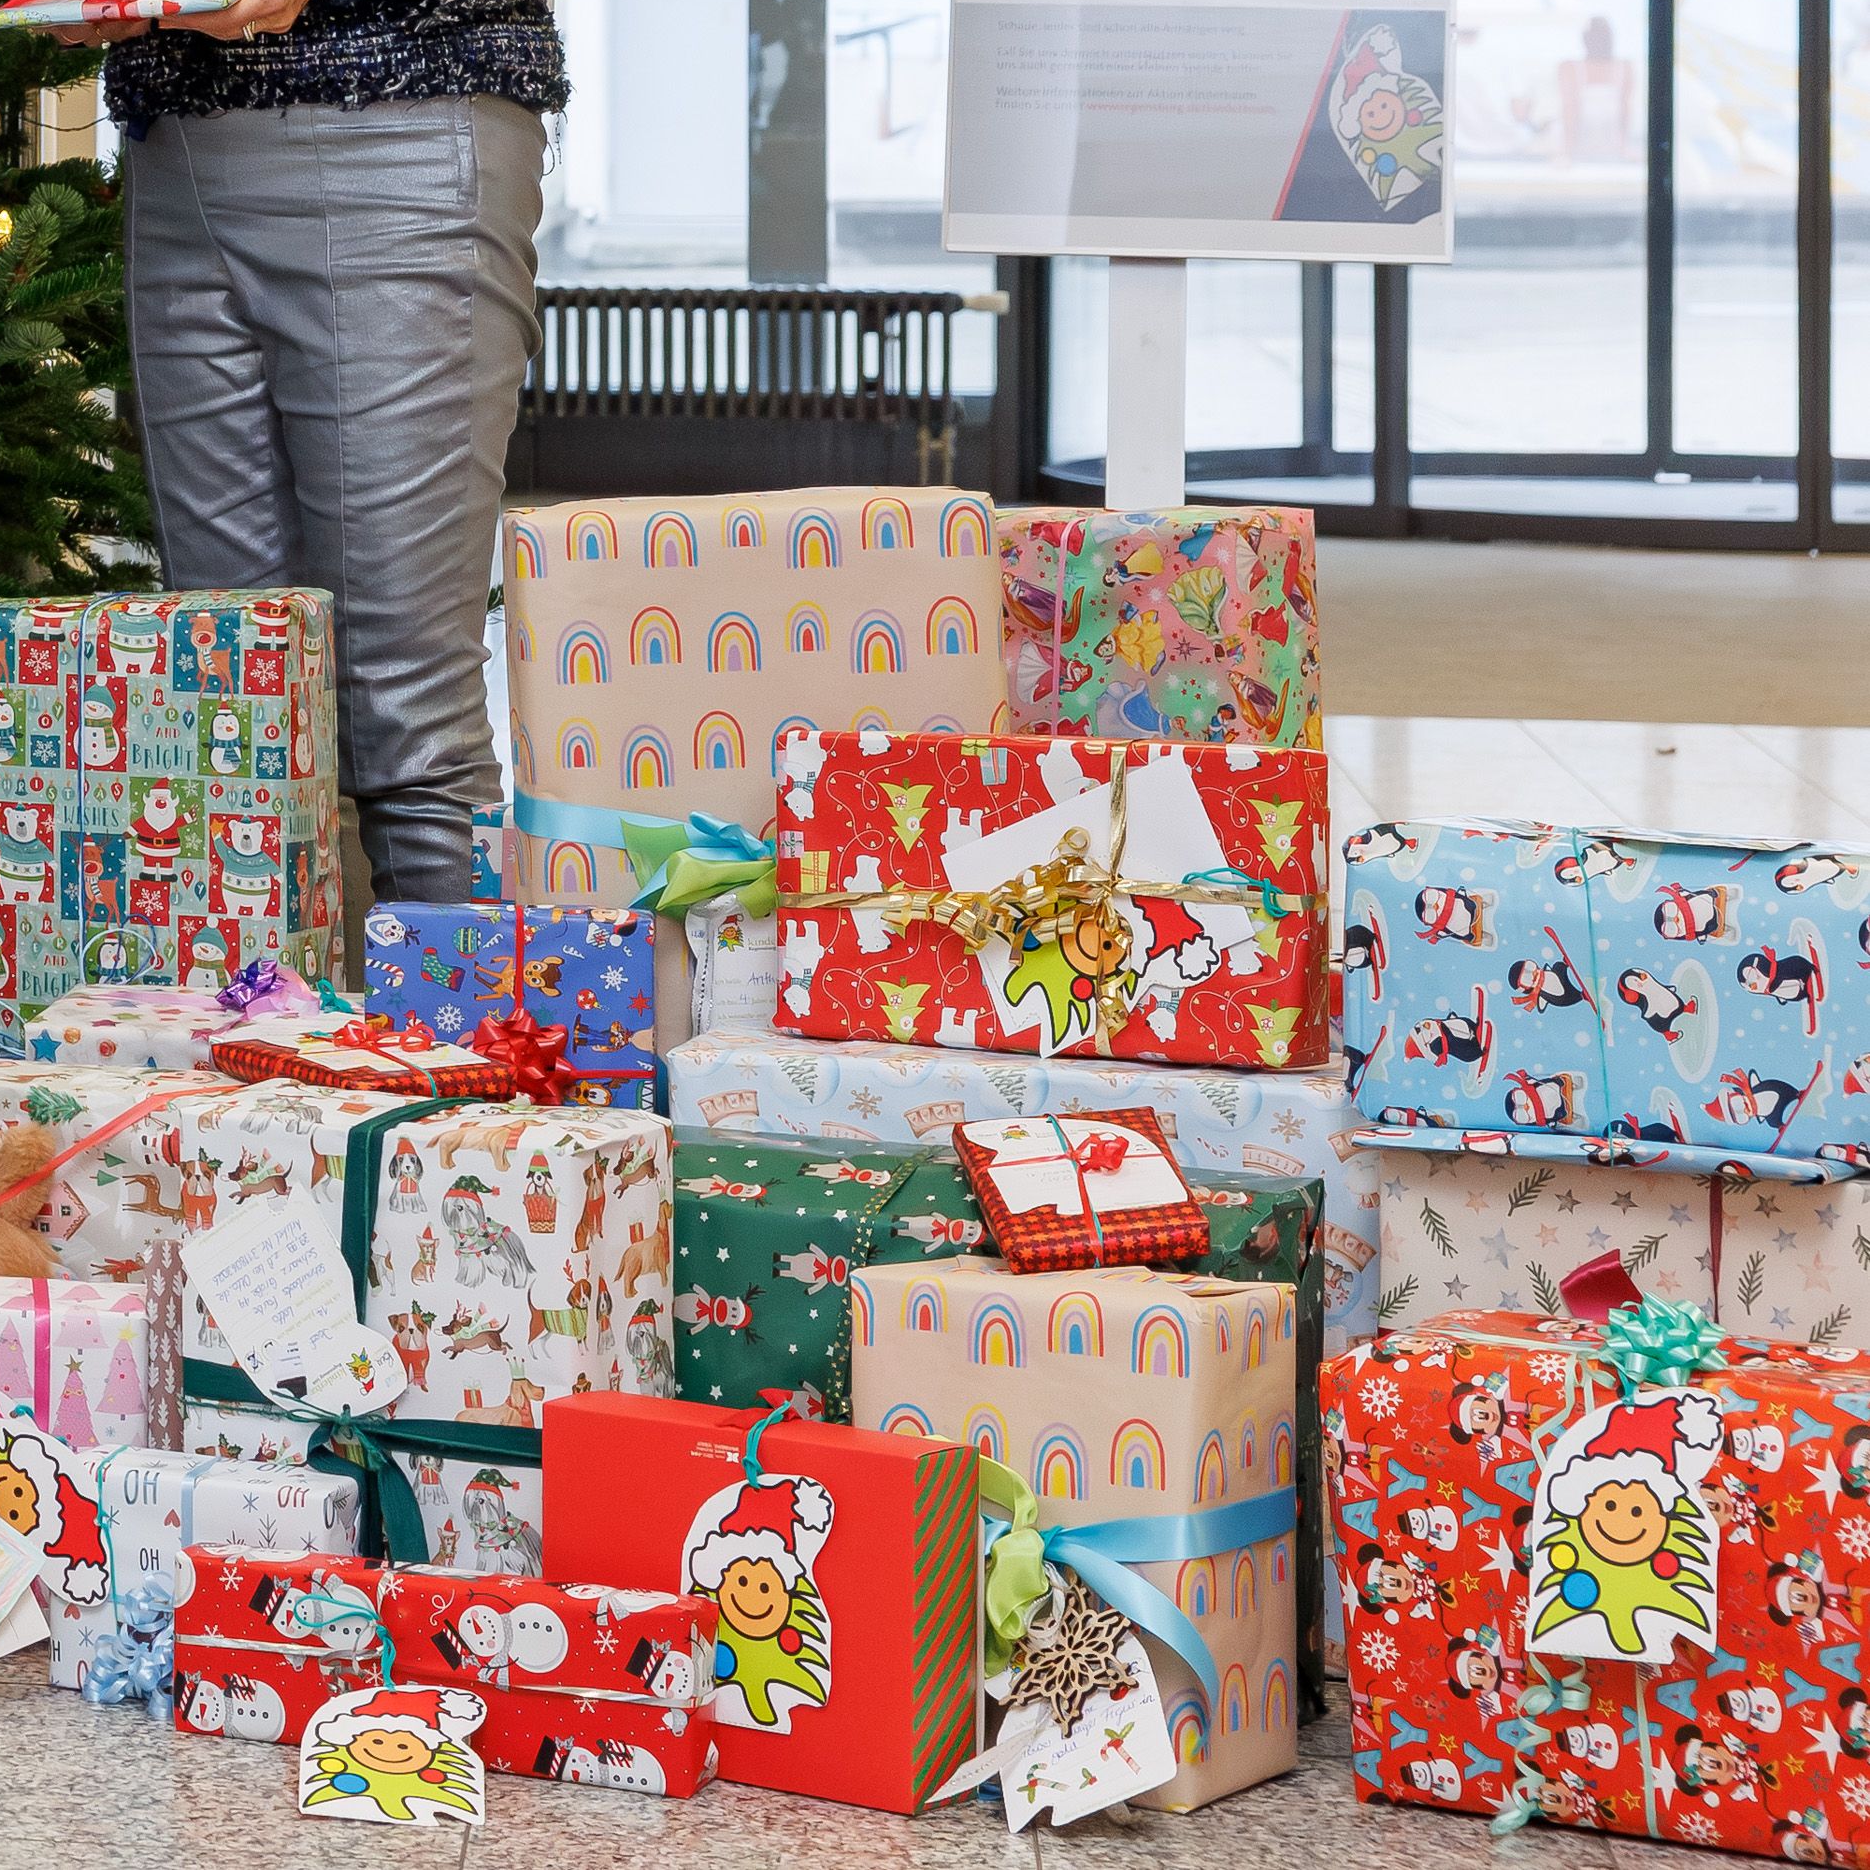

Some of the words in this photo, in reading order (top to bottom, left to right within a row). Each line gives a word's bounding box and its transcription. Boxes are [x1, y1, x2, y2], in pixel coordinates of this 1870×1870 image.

[156, 727, 180, 739] AND
[132, 743, 194, 772] BRIGHT
[43, 956, 69, 968] AND
